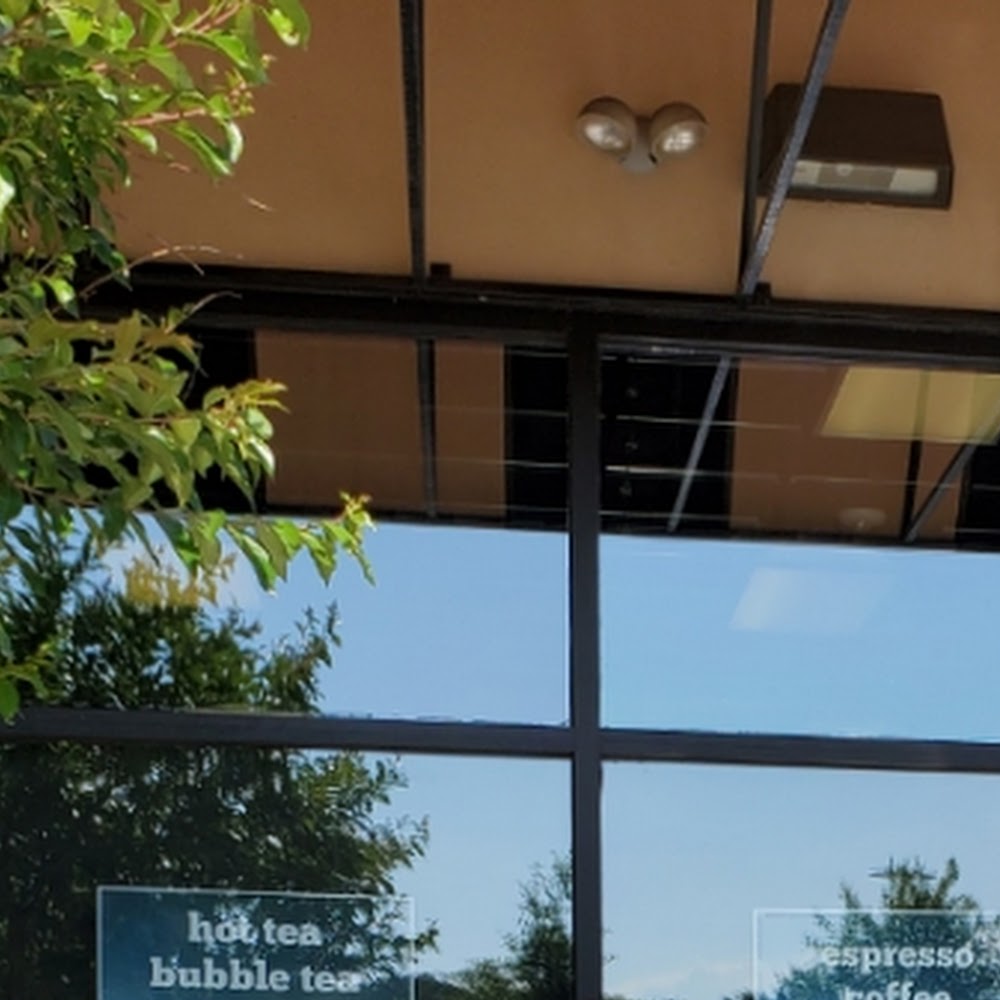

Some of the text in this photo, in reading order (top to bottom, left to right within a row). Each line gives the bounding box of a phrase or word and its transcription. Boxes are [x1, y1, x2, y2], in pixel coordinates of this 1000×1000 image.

[187, 909, 323, 947] hot tea
[149, 955, 362, 993] bubble tea
[822, 946, 974, 973] espresso
